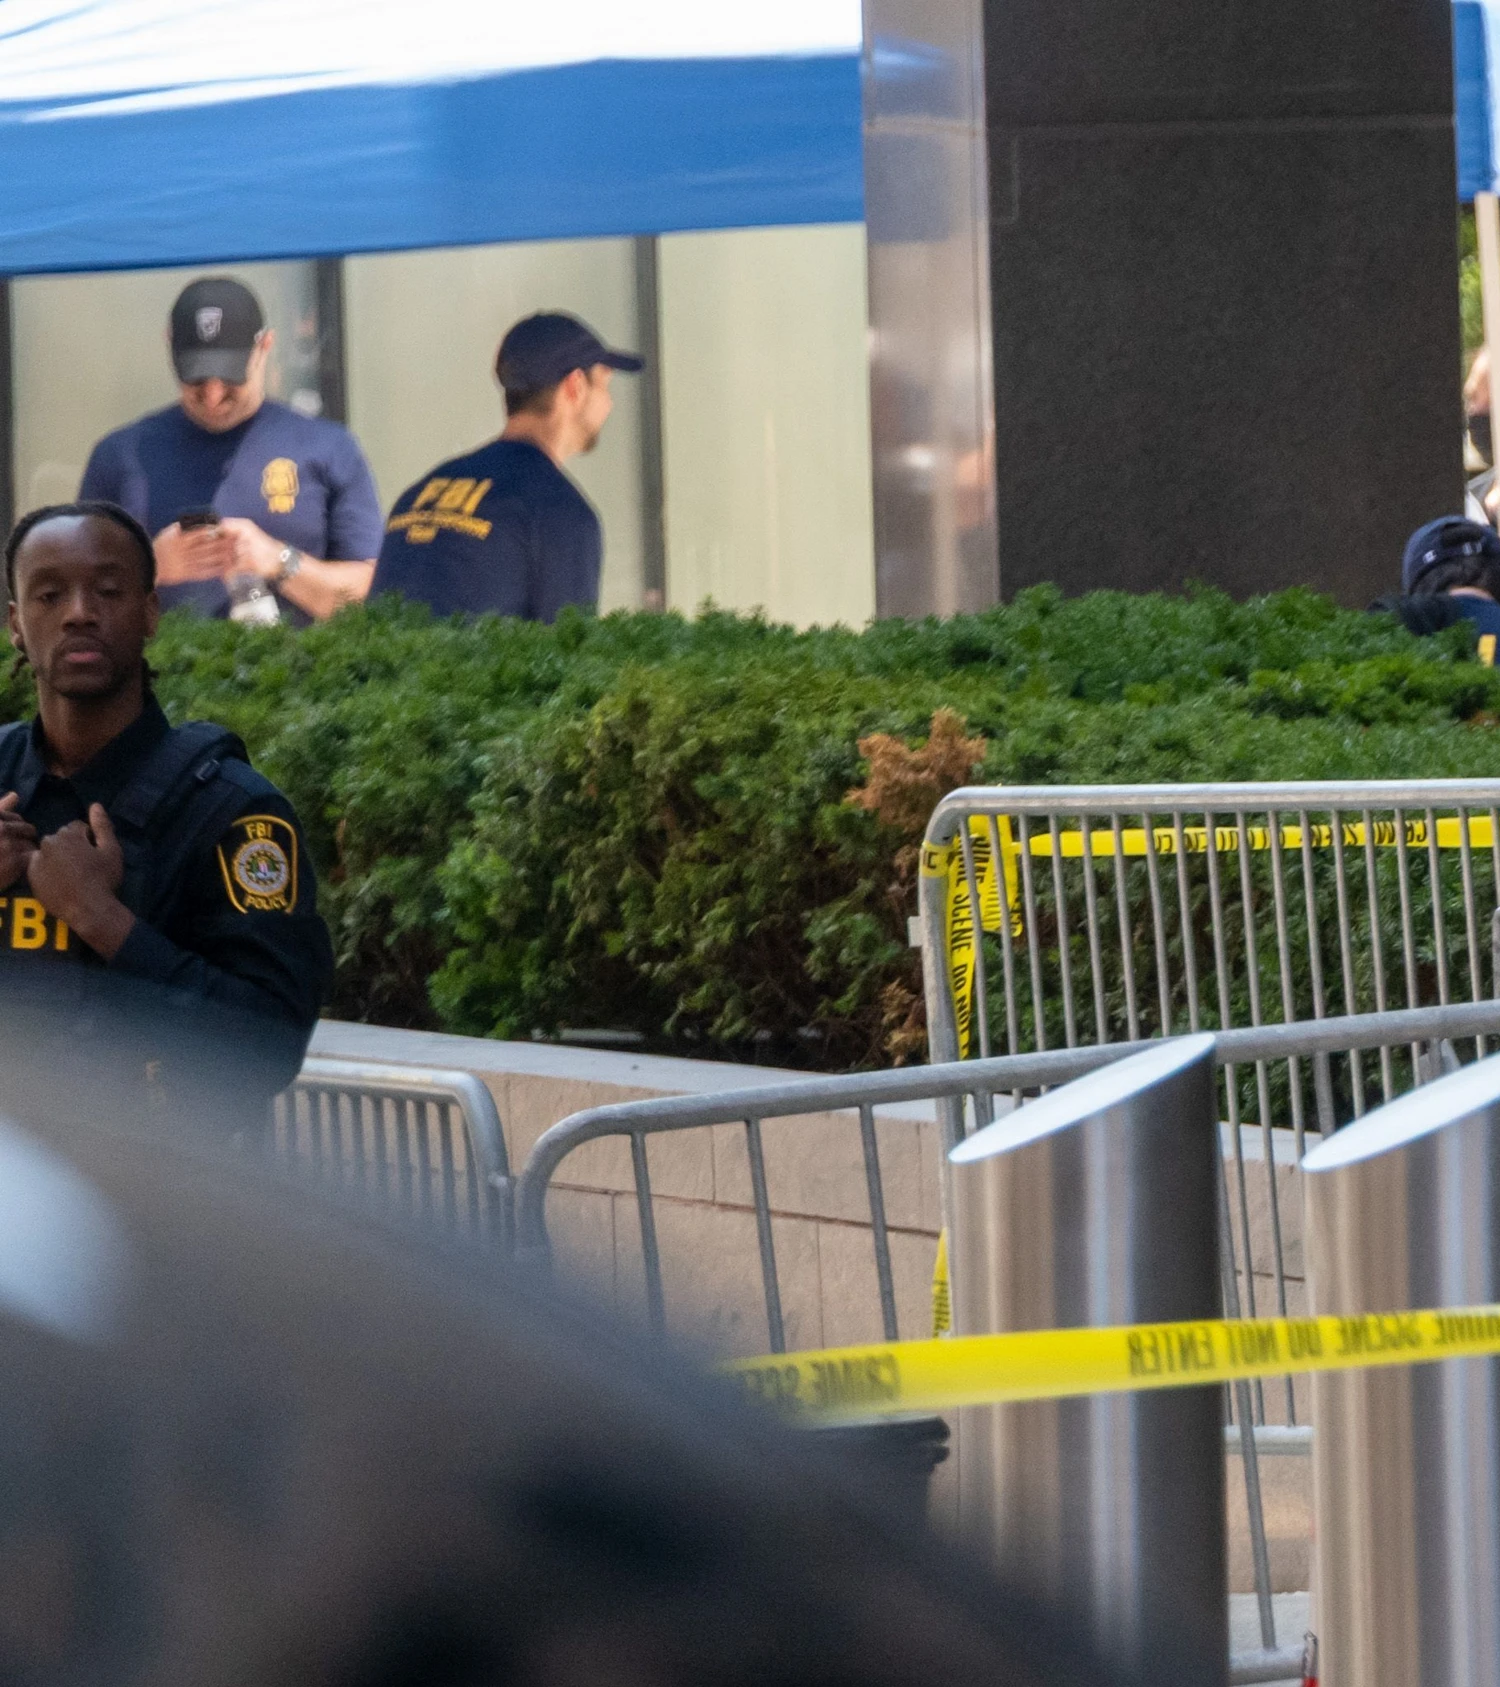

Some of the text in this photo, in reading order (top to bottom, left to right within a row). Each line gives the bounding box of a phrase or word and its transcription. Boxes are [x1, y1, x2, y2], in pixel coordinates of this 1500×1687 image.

[245, 823, 273, 840] FBI
[0, 897, 69, 951] BI
[951, 893, 975, 953] SCENE
[952, 963, 969, 993] DO
